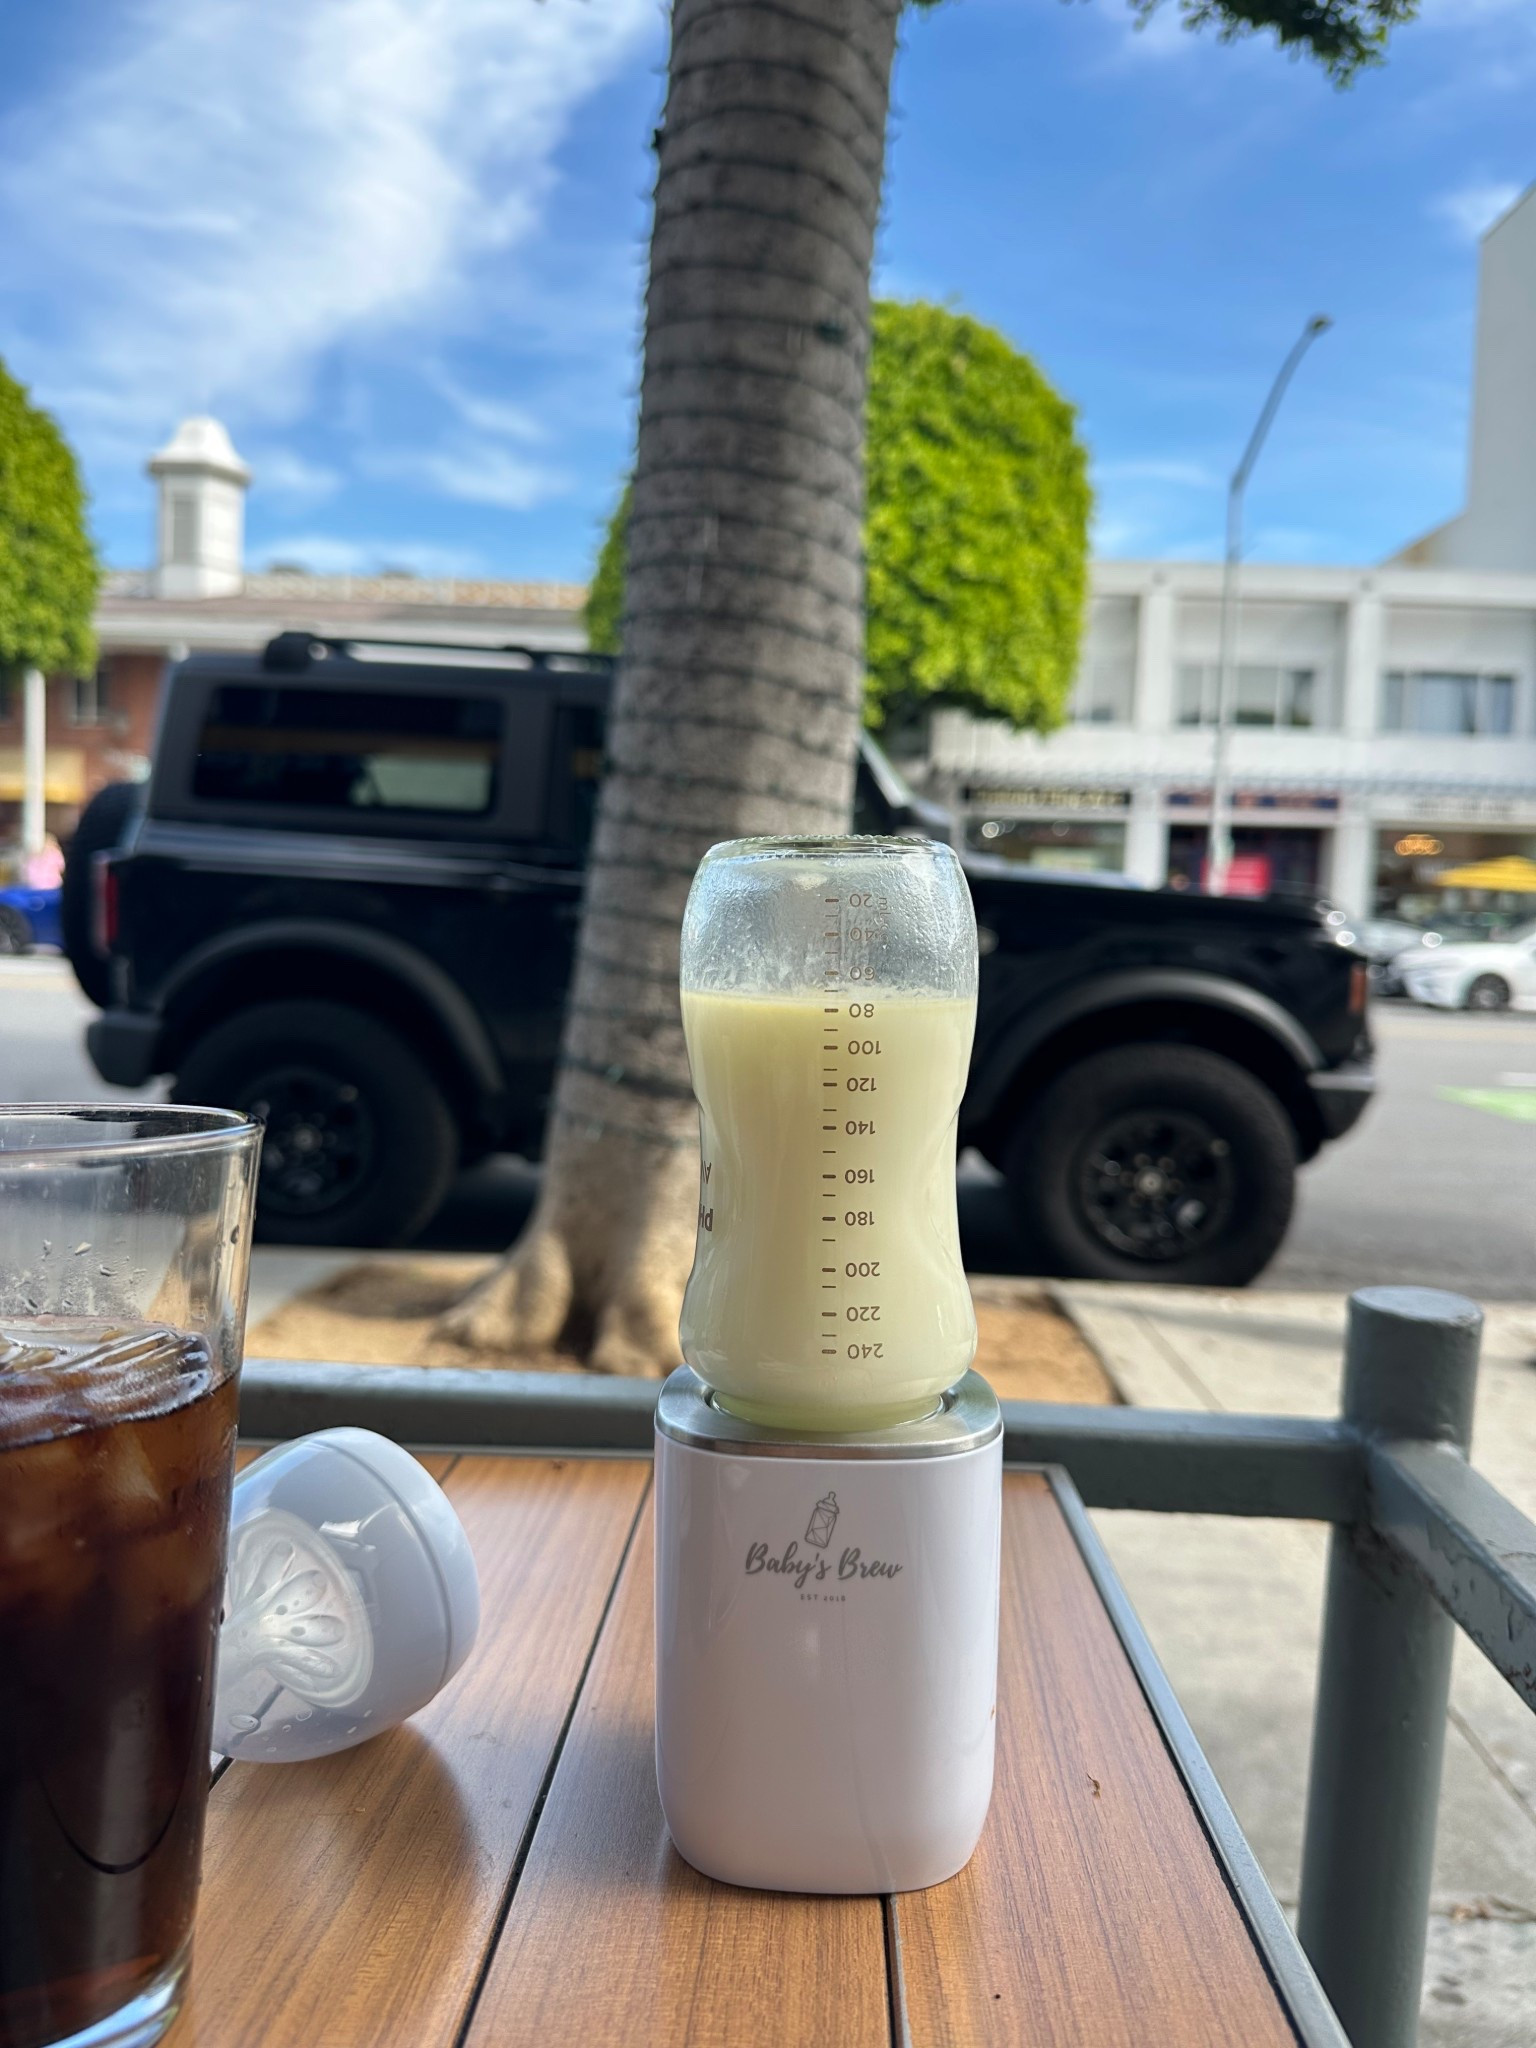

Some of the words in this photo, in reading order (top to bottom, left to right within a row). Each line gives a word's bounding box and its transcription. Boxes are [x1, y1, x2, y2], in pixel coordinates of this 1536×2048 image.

[849, 893, 873, 908] 20
[849, 927, 875, 941] 40
[849, 966, 875, 981] 60
[848, 1003, 875, 1018] 80
[847, 1040, 882, 1055] 100
[846, 1077, 878, 1092] 120
[845, 1120, 876, 1135] 140
[844, 1168, 875, 1184] 160
[844, 1211, 875, 1226] 180
[845, 1261, 881, 1277] 200
[846, 1306, 881, 1322] 220
[847, 1342, 884, 1359] 240
[745, 1541, 832, 1589] Baby's
[837, 1547, 903, 1581] Brew
[800, 1593, 818, 1601] EST
